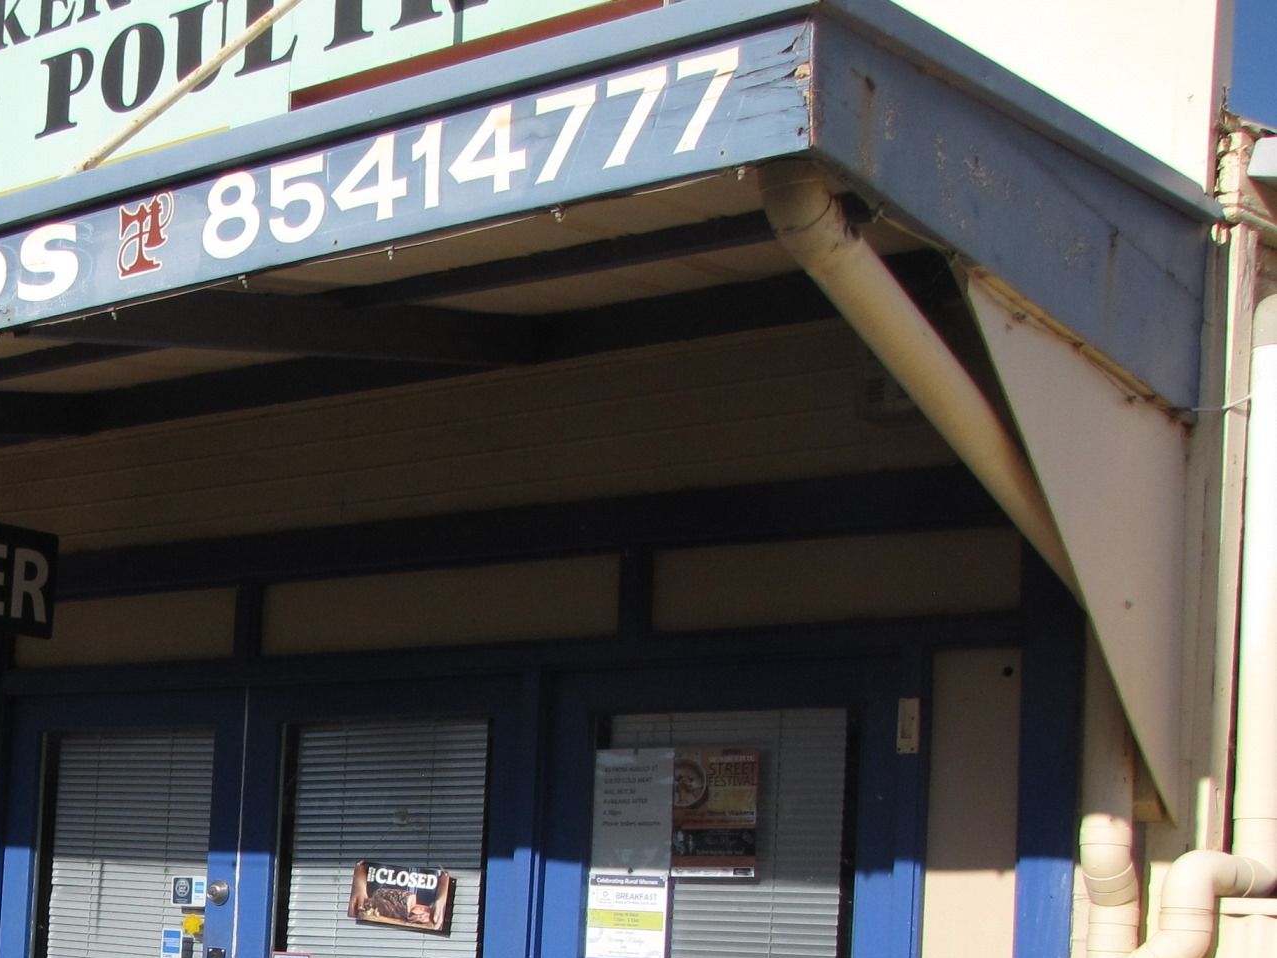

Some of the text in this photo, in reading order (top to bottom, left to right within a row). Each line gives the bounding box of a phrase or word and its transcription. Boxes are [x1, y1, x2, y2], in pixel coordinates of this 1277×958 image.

[201, 47, 740, 259] 85414777
[707, 762, 756, 776] STREET
[707, 776, 757, 786] FESTIVAL
[375, 867, 438, 890] CLOSED
[615, 891, 658, 901] BREAKFAST
